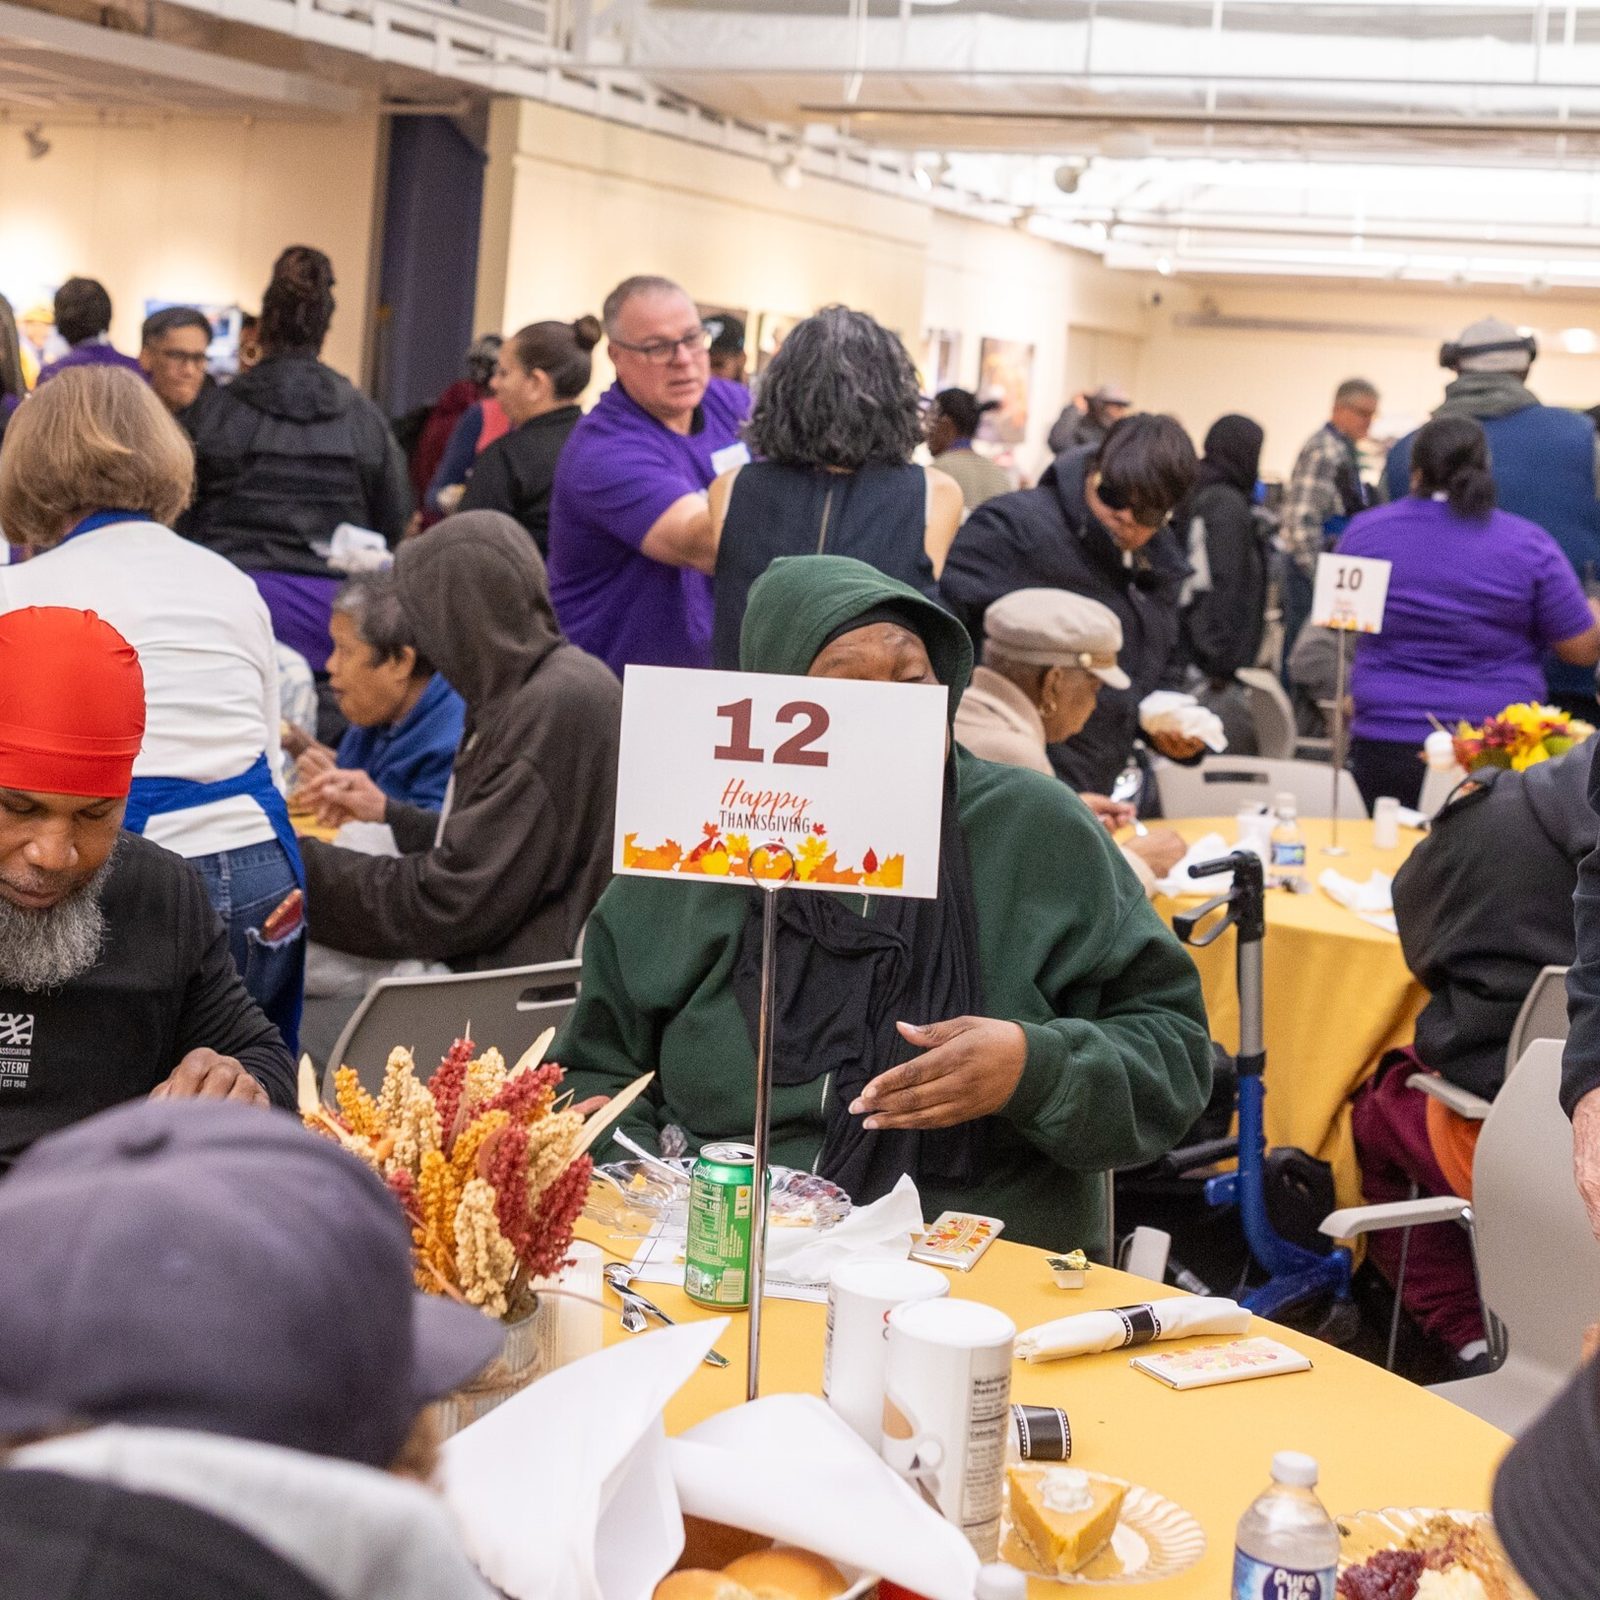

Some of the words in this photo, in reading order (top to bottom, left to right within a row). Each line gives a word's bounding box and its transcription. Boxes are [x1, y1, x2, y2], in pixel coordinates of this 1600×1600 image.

[1335, 567, 1363, 590] 10
[713, 698, 830, 767] 12
[719, 778, 813, 823] Happy
[719, 810, 811, 834] THANKSGIVING
[1274, 1568, 1316, 1591] Pure
